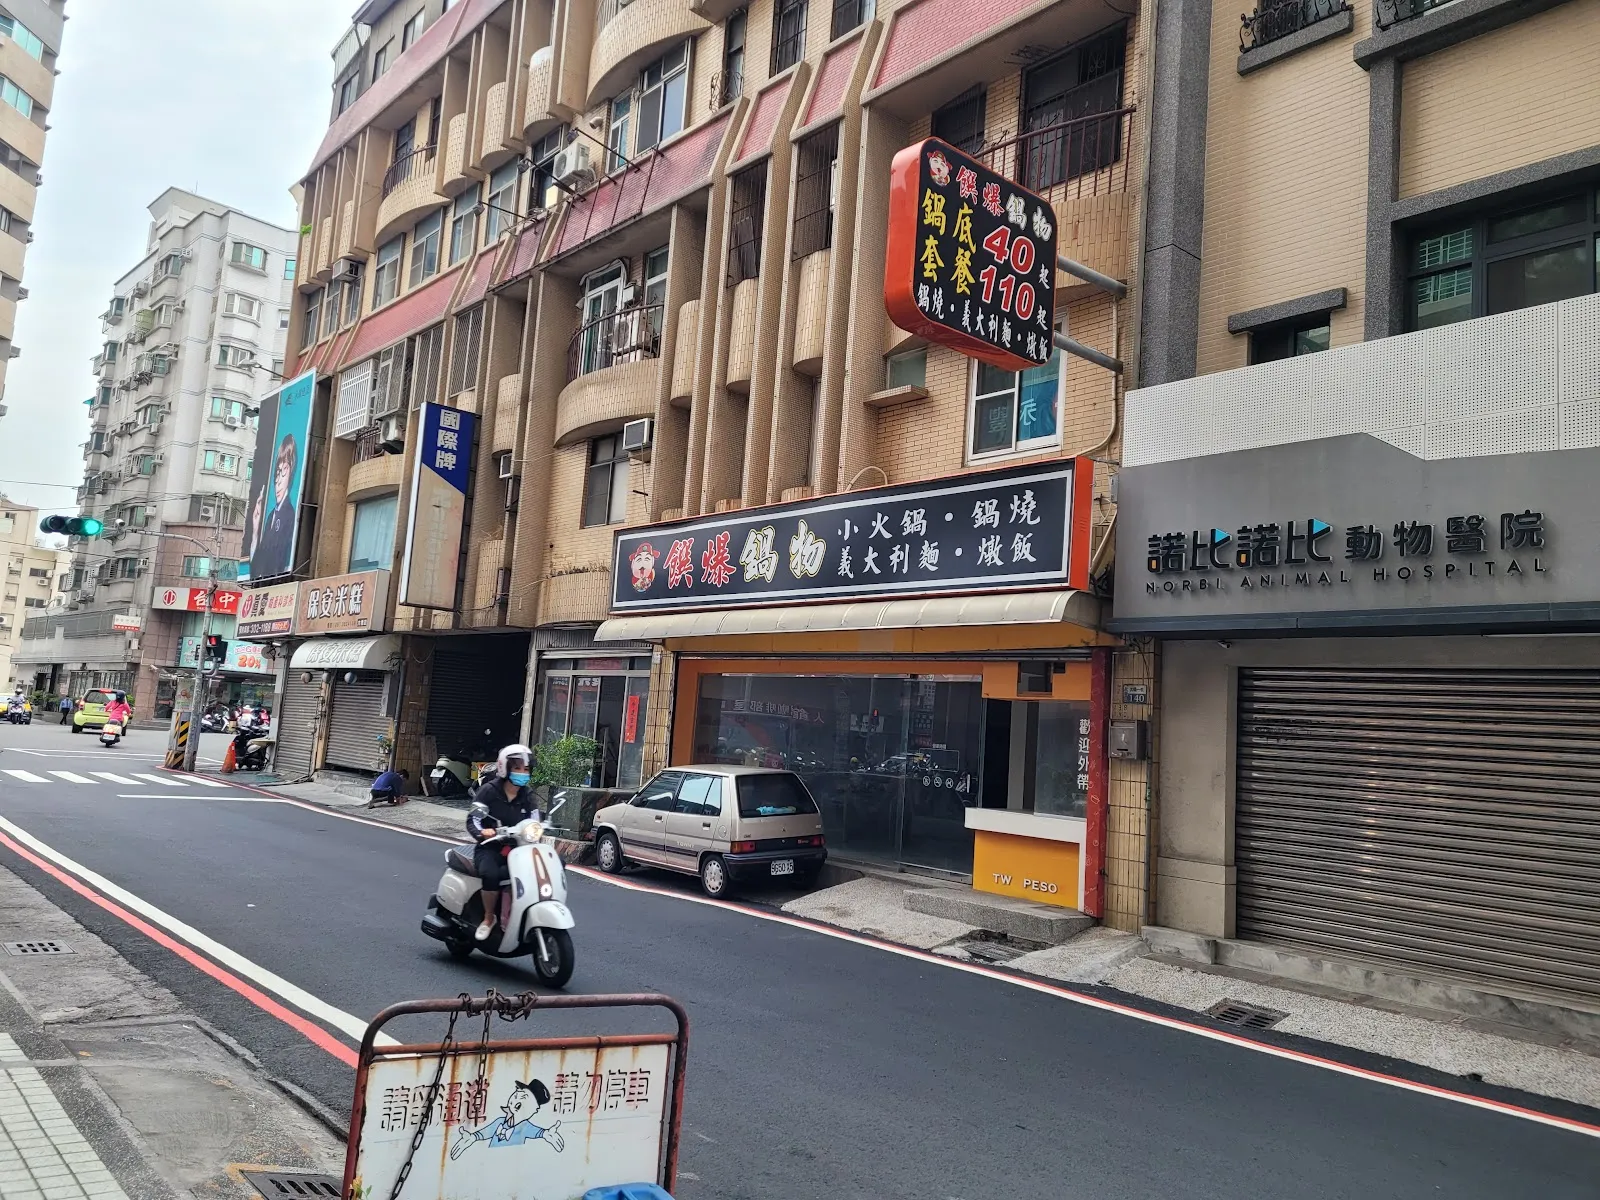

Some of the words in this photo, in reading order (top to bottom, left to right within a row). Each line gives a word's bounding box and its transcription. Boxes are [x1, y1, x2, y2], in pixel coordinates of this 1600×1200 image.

[921, 187, 977, 253] 鍋底
[983, 224, 1036, 275] 40
[1038, 263, 1050, 291] 起
[919, 234, 977, 296] 套餐
[979, 264, 1036, 321] 110
[1036, 304, 1048, 332] 起
[435, 408, 461, 471] 國際牌
[1146, 577, 1225, 594] NORBI
[1240, 570, 1350, 588] ANIMAL
[1373, 558, 1547, 581] HOSPITAL
[306, 581, 365, 620] 保安米糕
[305, 640, 371, 664] 保安米糕
[1129, 694, 1145, 703] 140
[1077, 718, 1091, 791] 歡迎外帶
[993, 872, 1013, 886] TW
[1023, 878, 1059, 894] PESO
[554, 1067, 651, 1115] 請勿停車
